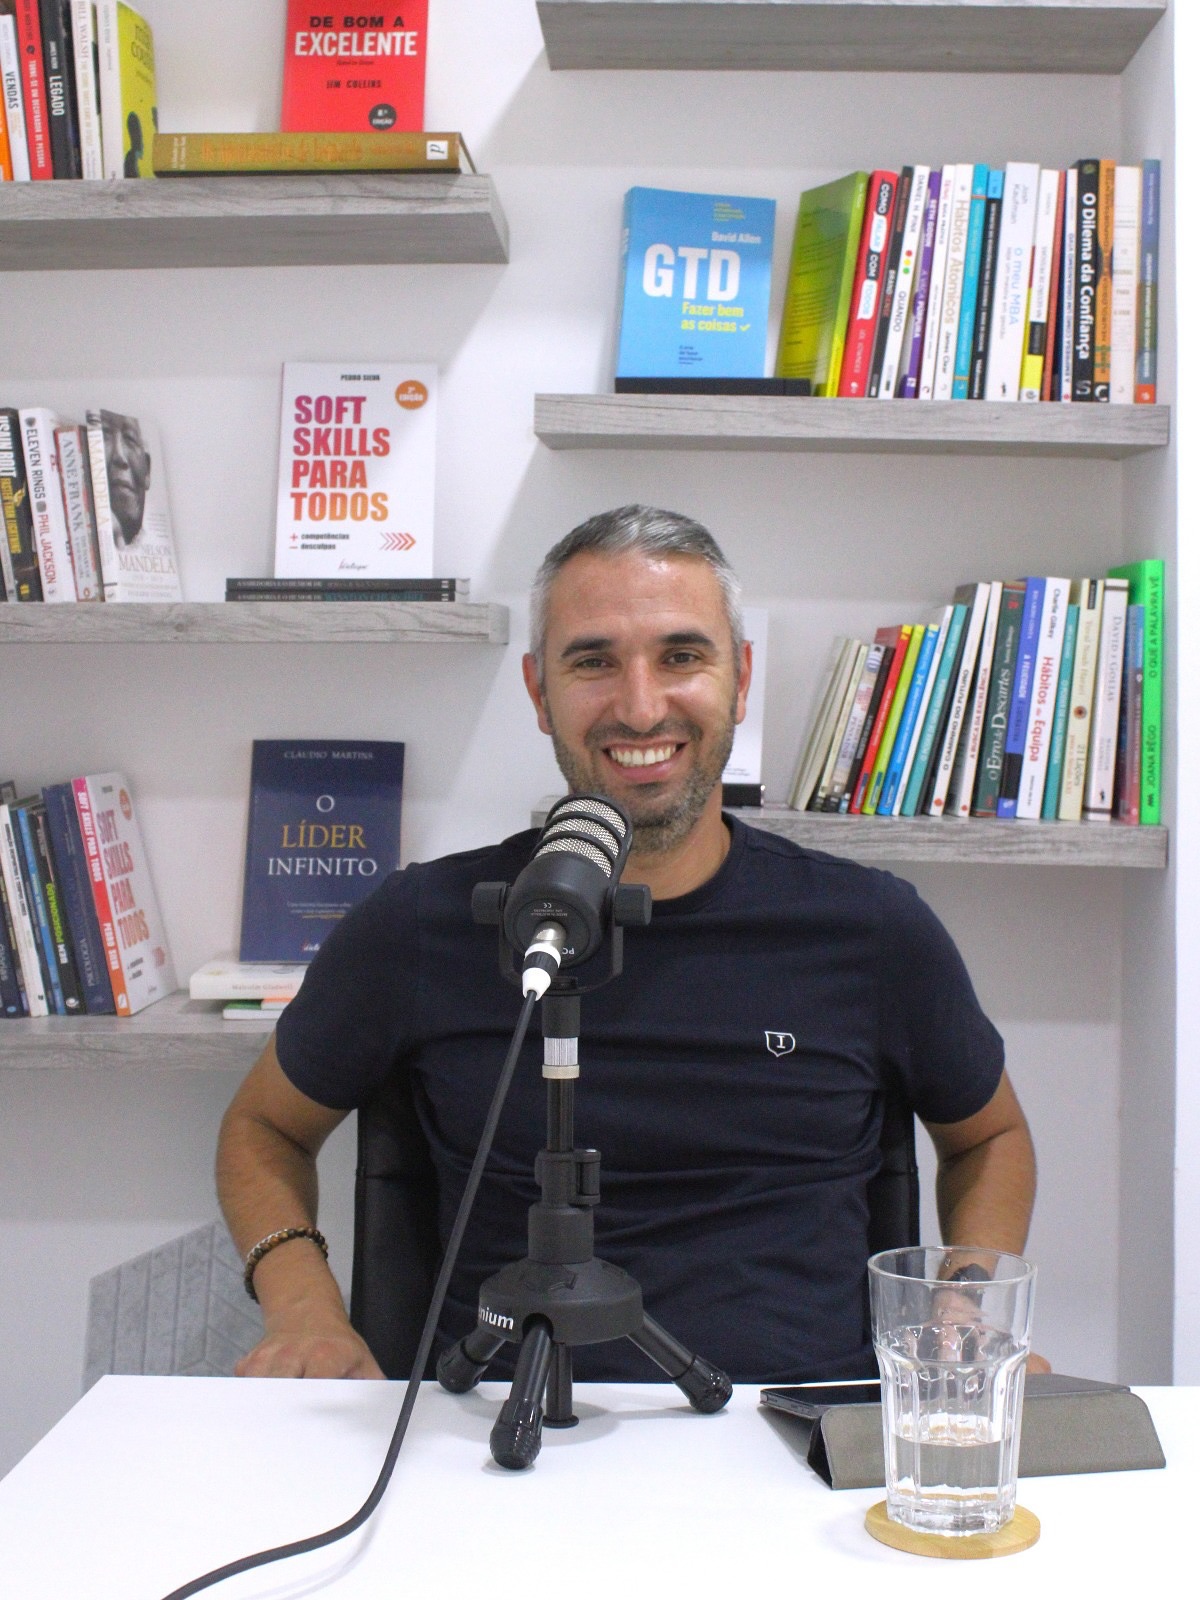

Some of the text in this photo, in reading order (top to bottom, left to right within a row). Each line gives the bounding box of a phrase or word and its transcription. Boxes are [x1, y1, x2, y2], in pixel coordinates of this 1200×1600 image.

[310, 16, 404, 28] DE BOM A
[79, 25, 89, 58] WALSH
[294, 32, 418, 56] EXCELENTE
[5, 72, 18, 109] VENDAS
[49, 76, 65, 116] LEGADO
[346, 80, 382, 88] COLLINS
[36, 143, 45, 168] PESSOAS
[878, 184, 890, 213] COMO
[914, 174, 924, 203] DANIEL
[1011, 184, 1020, 224] Kaufman
[712, 231, 761, 244] David Allen
[873, 218, 885, 245] FALAR
[909, 215, 918, 233] PINK
[925, 199, 937, 248] SETH GODIN
[642, 244, 740, 301] GTD
[868, 253, 879, 275] COM
[1012, 261, 1022, 288] meu
[1076, 193, 1096, 359] O Dilema da Confiança
[682, 302, 744, 317] Fazer bem
[893, 290, 906, 332] QUANDO
[1009, 293, 1021, 325] MBA
[681, 319, 736, 332] as coisas
[943, 331, 951, 353] James
[294, 396, 366, 424] SOFT
[293, 428, 390, 457] SKILLS
[0, 450, 17, 479] BOLT
[26, 429, 45, 499] ELEVEN RINGS
[292, 460, 368, 488] PARA
[63, 439, 84, 532] ANNE FRANK
[89, 438, 110, 526] MANDELA
[290, 492, 389, 521] TODOS
[38, 514, 56, 584] PHIL JACKSON
[118, 554, 176, 573] MANDELA
[1051, 589, 1061, 614] Charlie
[1150, 592, 1159, 636] PALAVRA
[1111, 616, 1122, 652] DAVID
[1078, 621, 1092, 695] Yuval Noah Harari
[1150, 650, 1158, 669] QUE
[957, 669, 969, 704] FUTURO
[976, 669, 988, 715] EXCELÊNCIA
[1018, 662, 1030, 699] FELICIDADE
[1037, 657, 1054, 705] Hábitos
[1107, 662, 1119, 701] GOLIAS
[954, 706, 961, 719] DO
[992, 669, 1012, 730] Descartes
[975, 717, 981, 726] DA
[945, 721, 958, 762] CAMINHO
[971, 728, 980, 753] BUSCA
[1028, 720, 1045, 762] Equipa
[987, 743, 1003, 770] Erro
[1073, 744, 1086, 785] 21 Lições
[989, 771, 998, 781] O
[316, 794, 335, 812] O
[78, 791, 102, 882] SOFT SKILLS PARA TODOS
[281, 819, 367, 848] LÍDER
[268, 858, 378, 876] INFINITO
[46, 884, 69, 965] BEM POSICIONADO
[103, 922, 120, 971] PEDRO SILVA
[80, 939, 95, 988] PSICOLOGIA
[479, 1307, 514, 1330] nium
